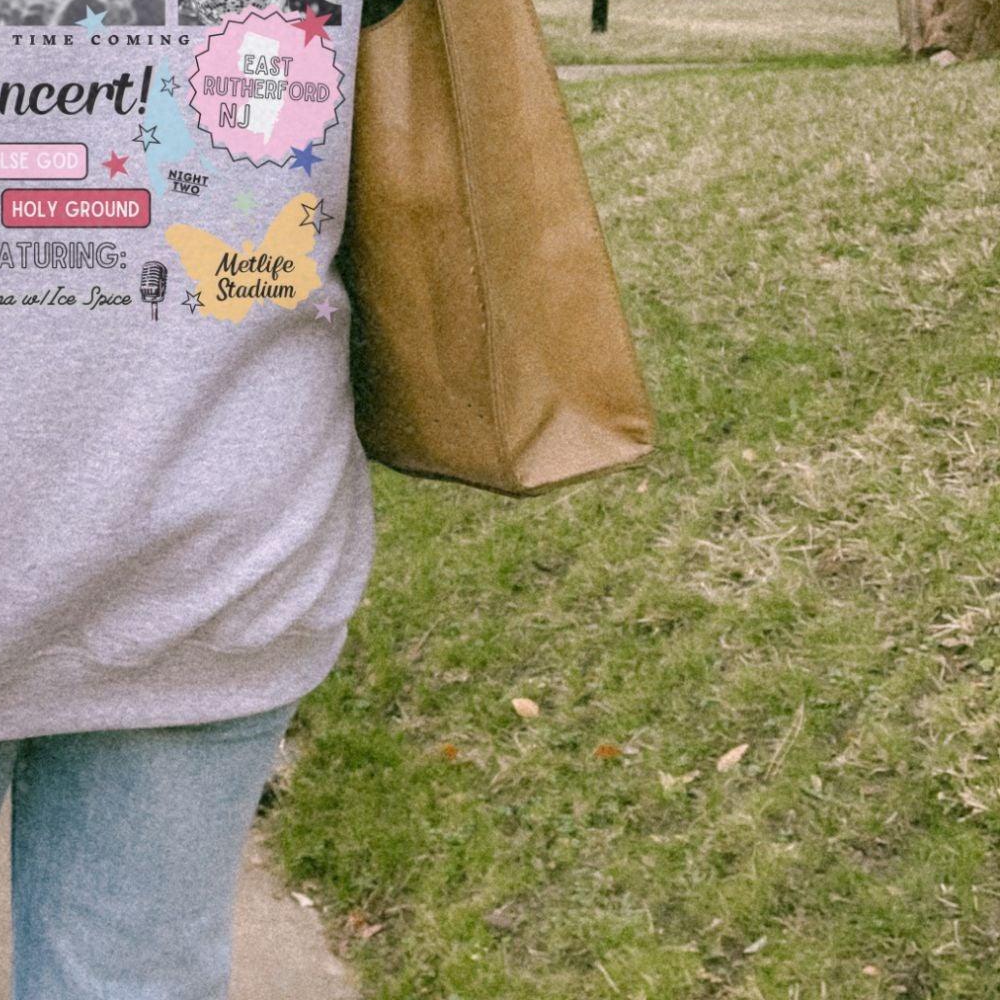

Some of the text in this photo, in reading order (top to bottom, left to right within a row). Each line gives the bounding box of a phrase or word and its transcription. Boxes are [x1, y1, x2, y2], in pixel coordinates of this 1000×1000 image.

[12, 34, 74, 46] TIME
[90, 34, 190, 46] COMING
[243, 54, 293, 77] EAST
[203, 76, 331, 103] RUTHERFORD
[218, 102, 250, 128] NJ
[36, 152, 79, 169] GOD
[168, 169, 209, 187] NIGHT
[172, 182, 201, 196] TWO
[12, 201, 140, 217] HOLY GROUND
[214, 252, 295, 281] Metlife
[82, 285, 133, 311] Spice
[216, 277, 296, 302] Stadium
